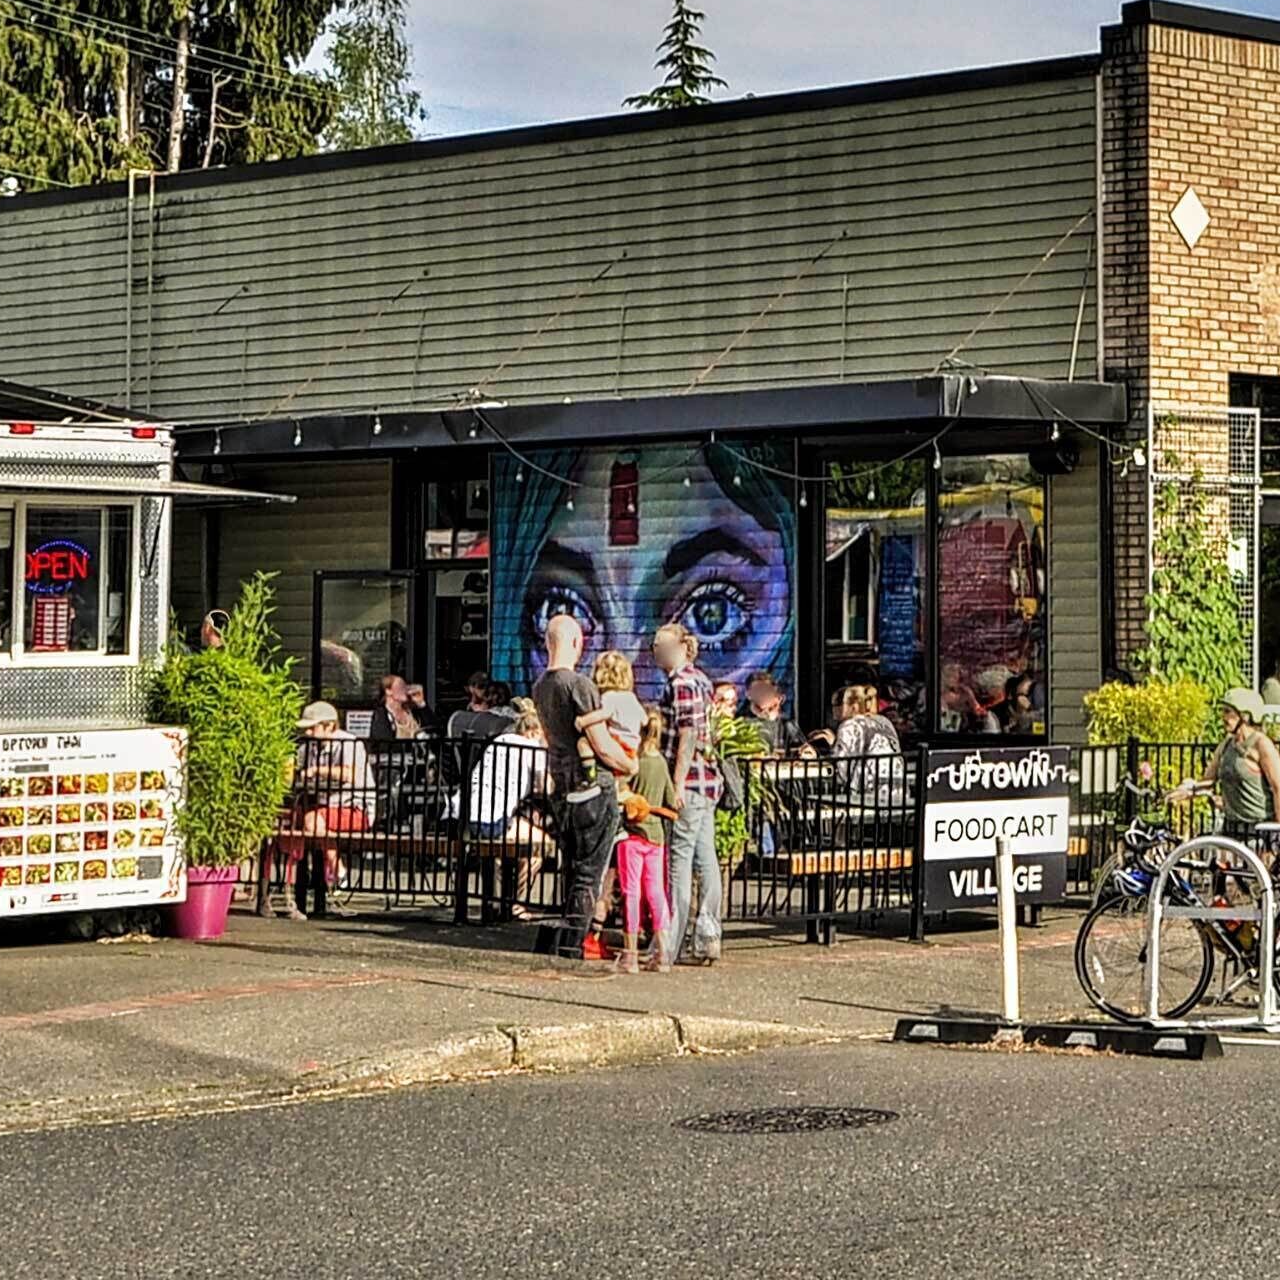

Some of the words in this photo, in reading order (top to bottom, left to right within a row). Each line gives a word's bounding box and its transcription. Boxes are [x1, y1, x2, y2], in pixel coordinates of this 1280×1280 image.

[949, 757, 1049, 790] UPTOWN
[935, 817, 996, 843] FOOD
[1002, 814, 1058, 838] CART
[949, 865, 1043, 897] VILLGE
